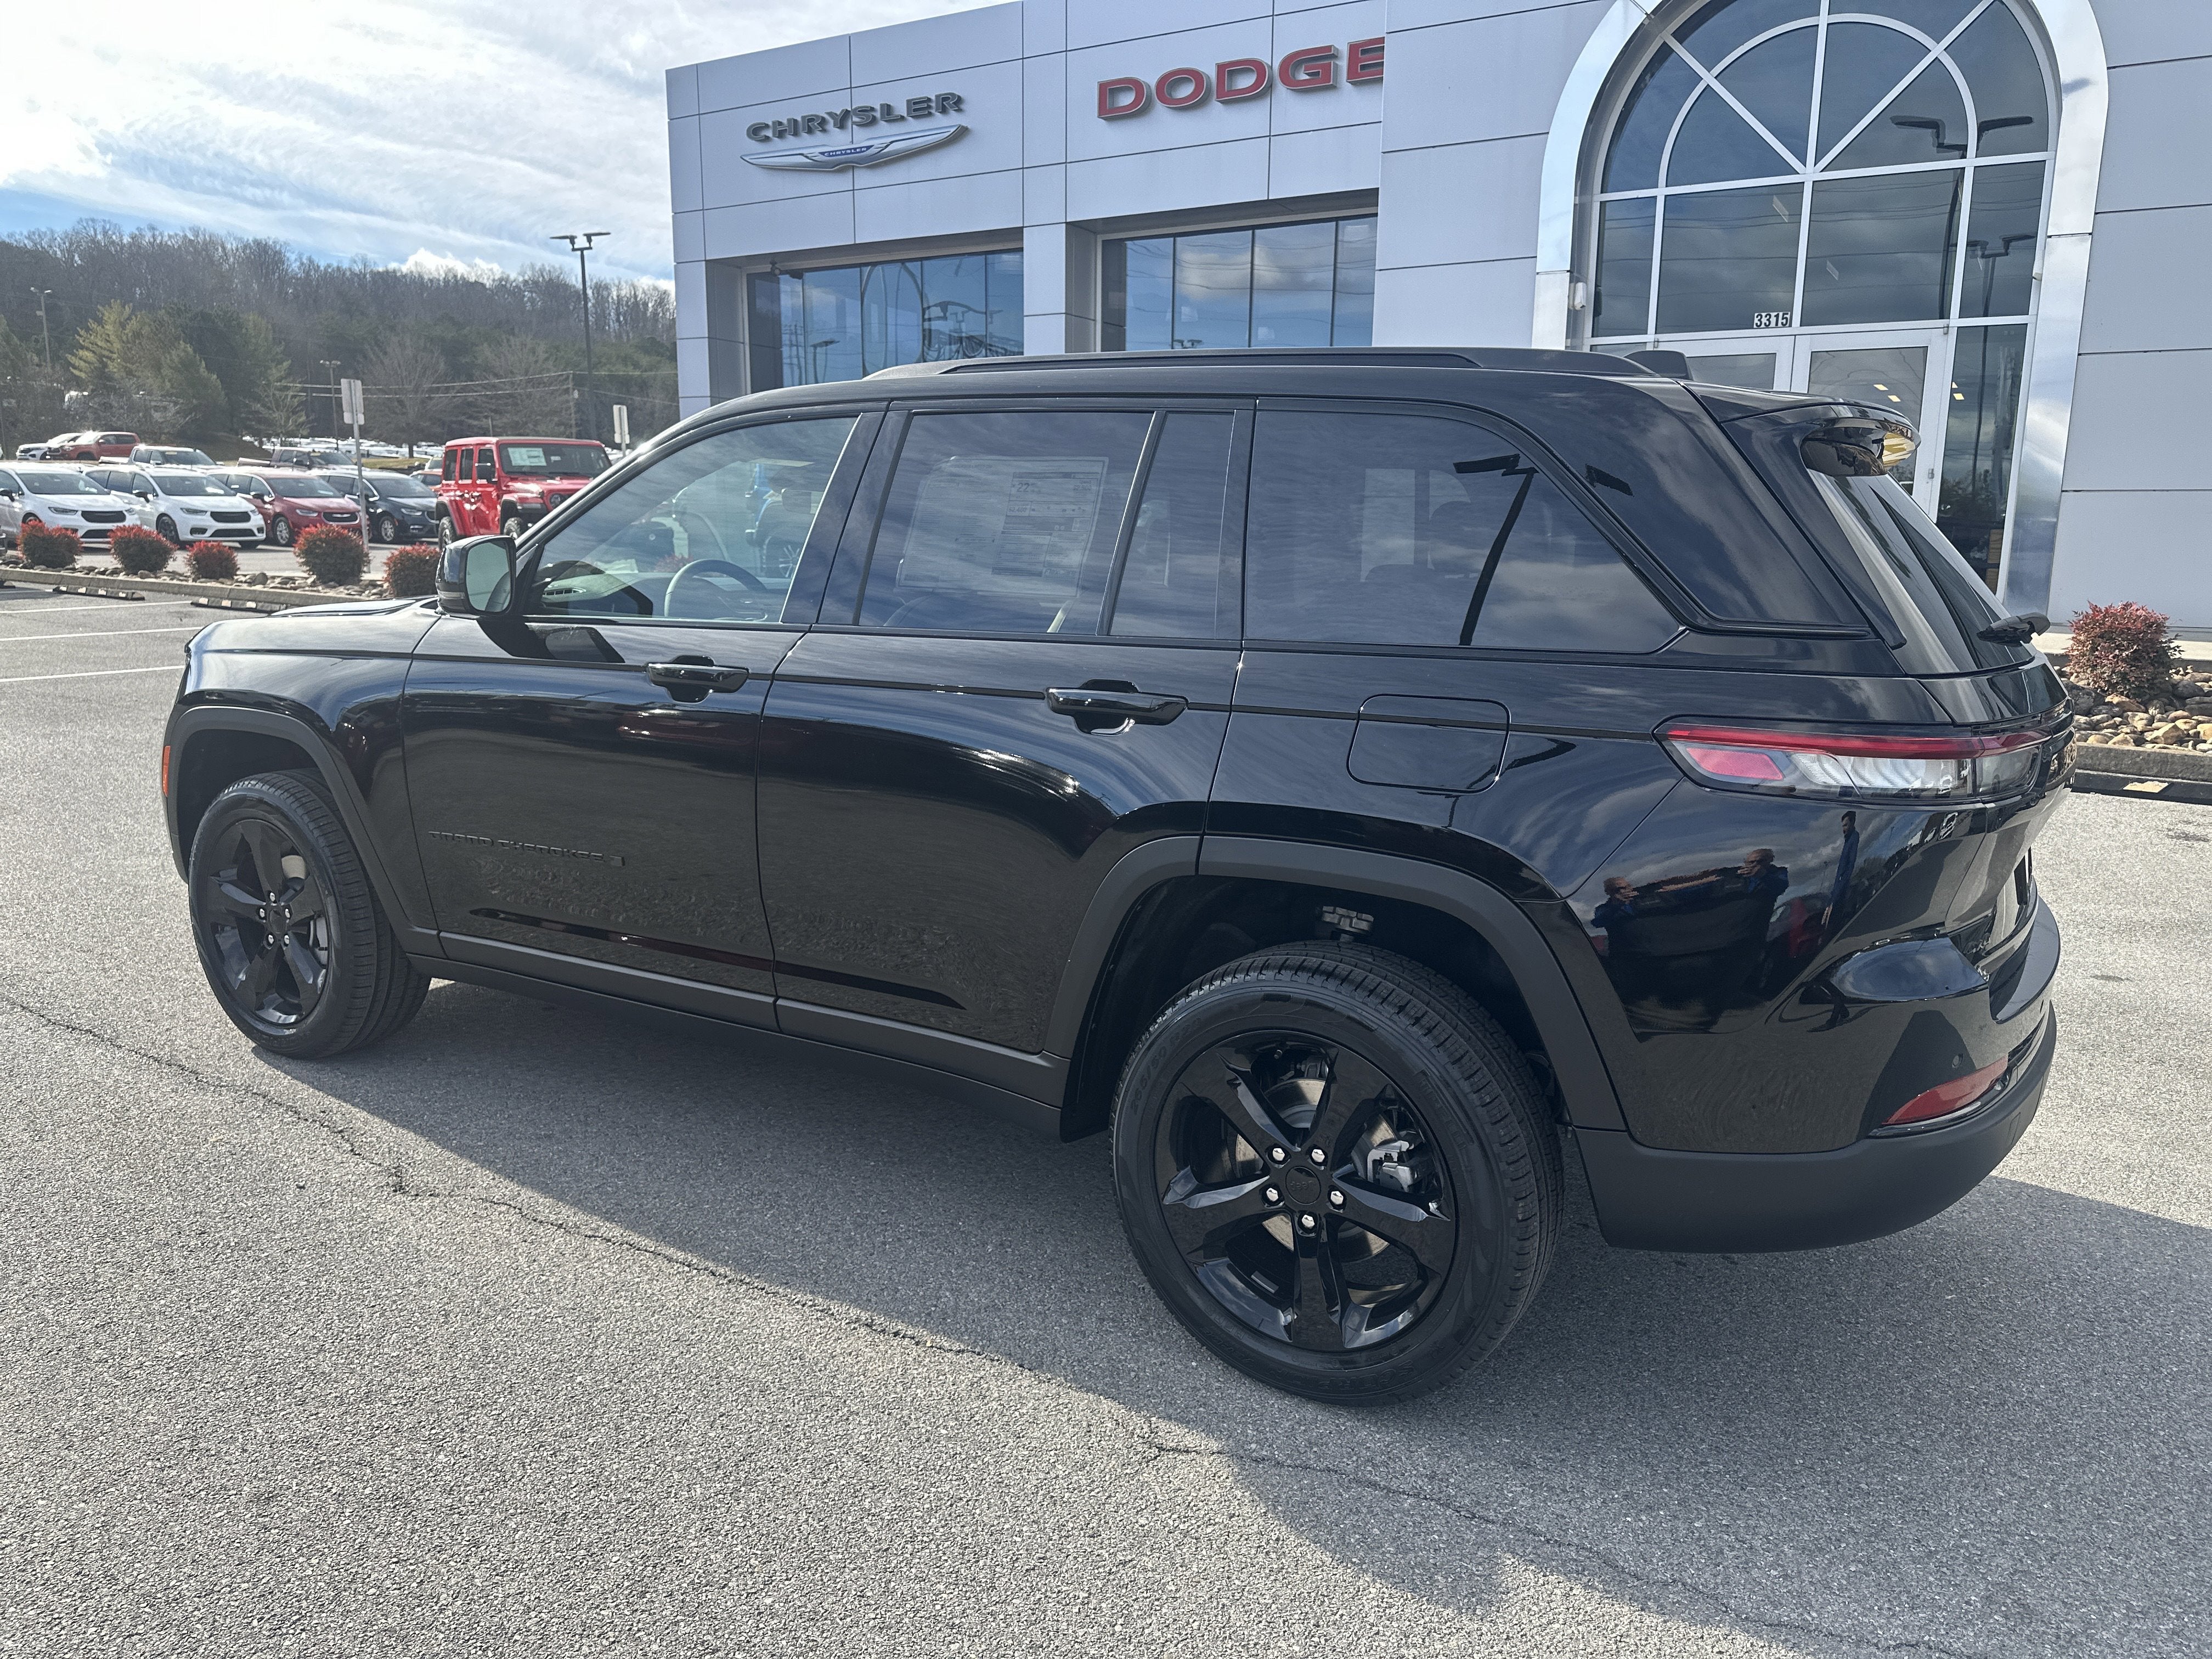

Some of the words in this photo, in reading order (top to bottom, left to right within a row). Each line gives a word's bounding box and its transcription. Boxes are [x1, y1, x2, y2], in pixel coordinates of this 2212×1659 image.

[1097, 36, 1385, 119] DODGE
[746, 92, 963, 142] CHRYSLER
[824, 148, 867, 156] CHRYSLER
[1755, 313, 1789, 328] 3315
